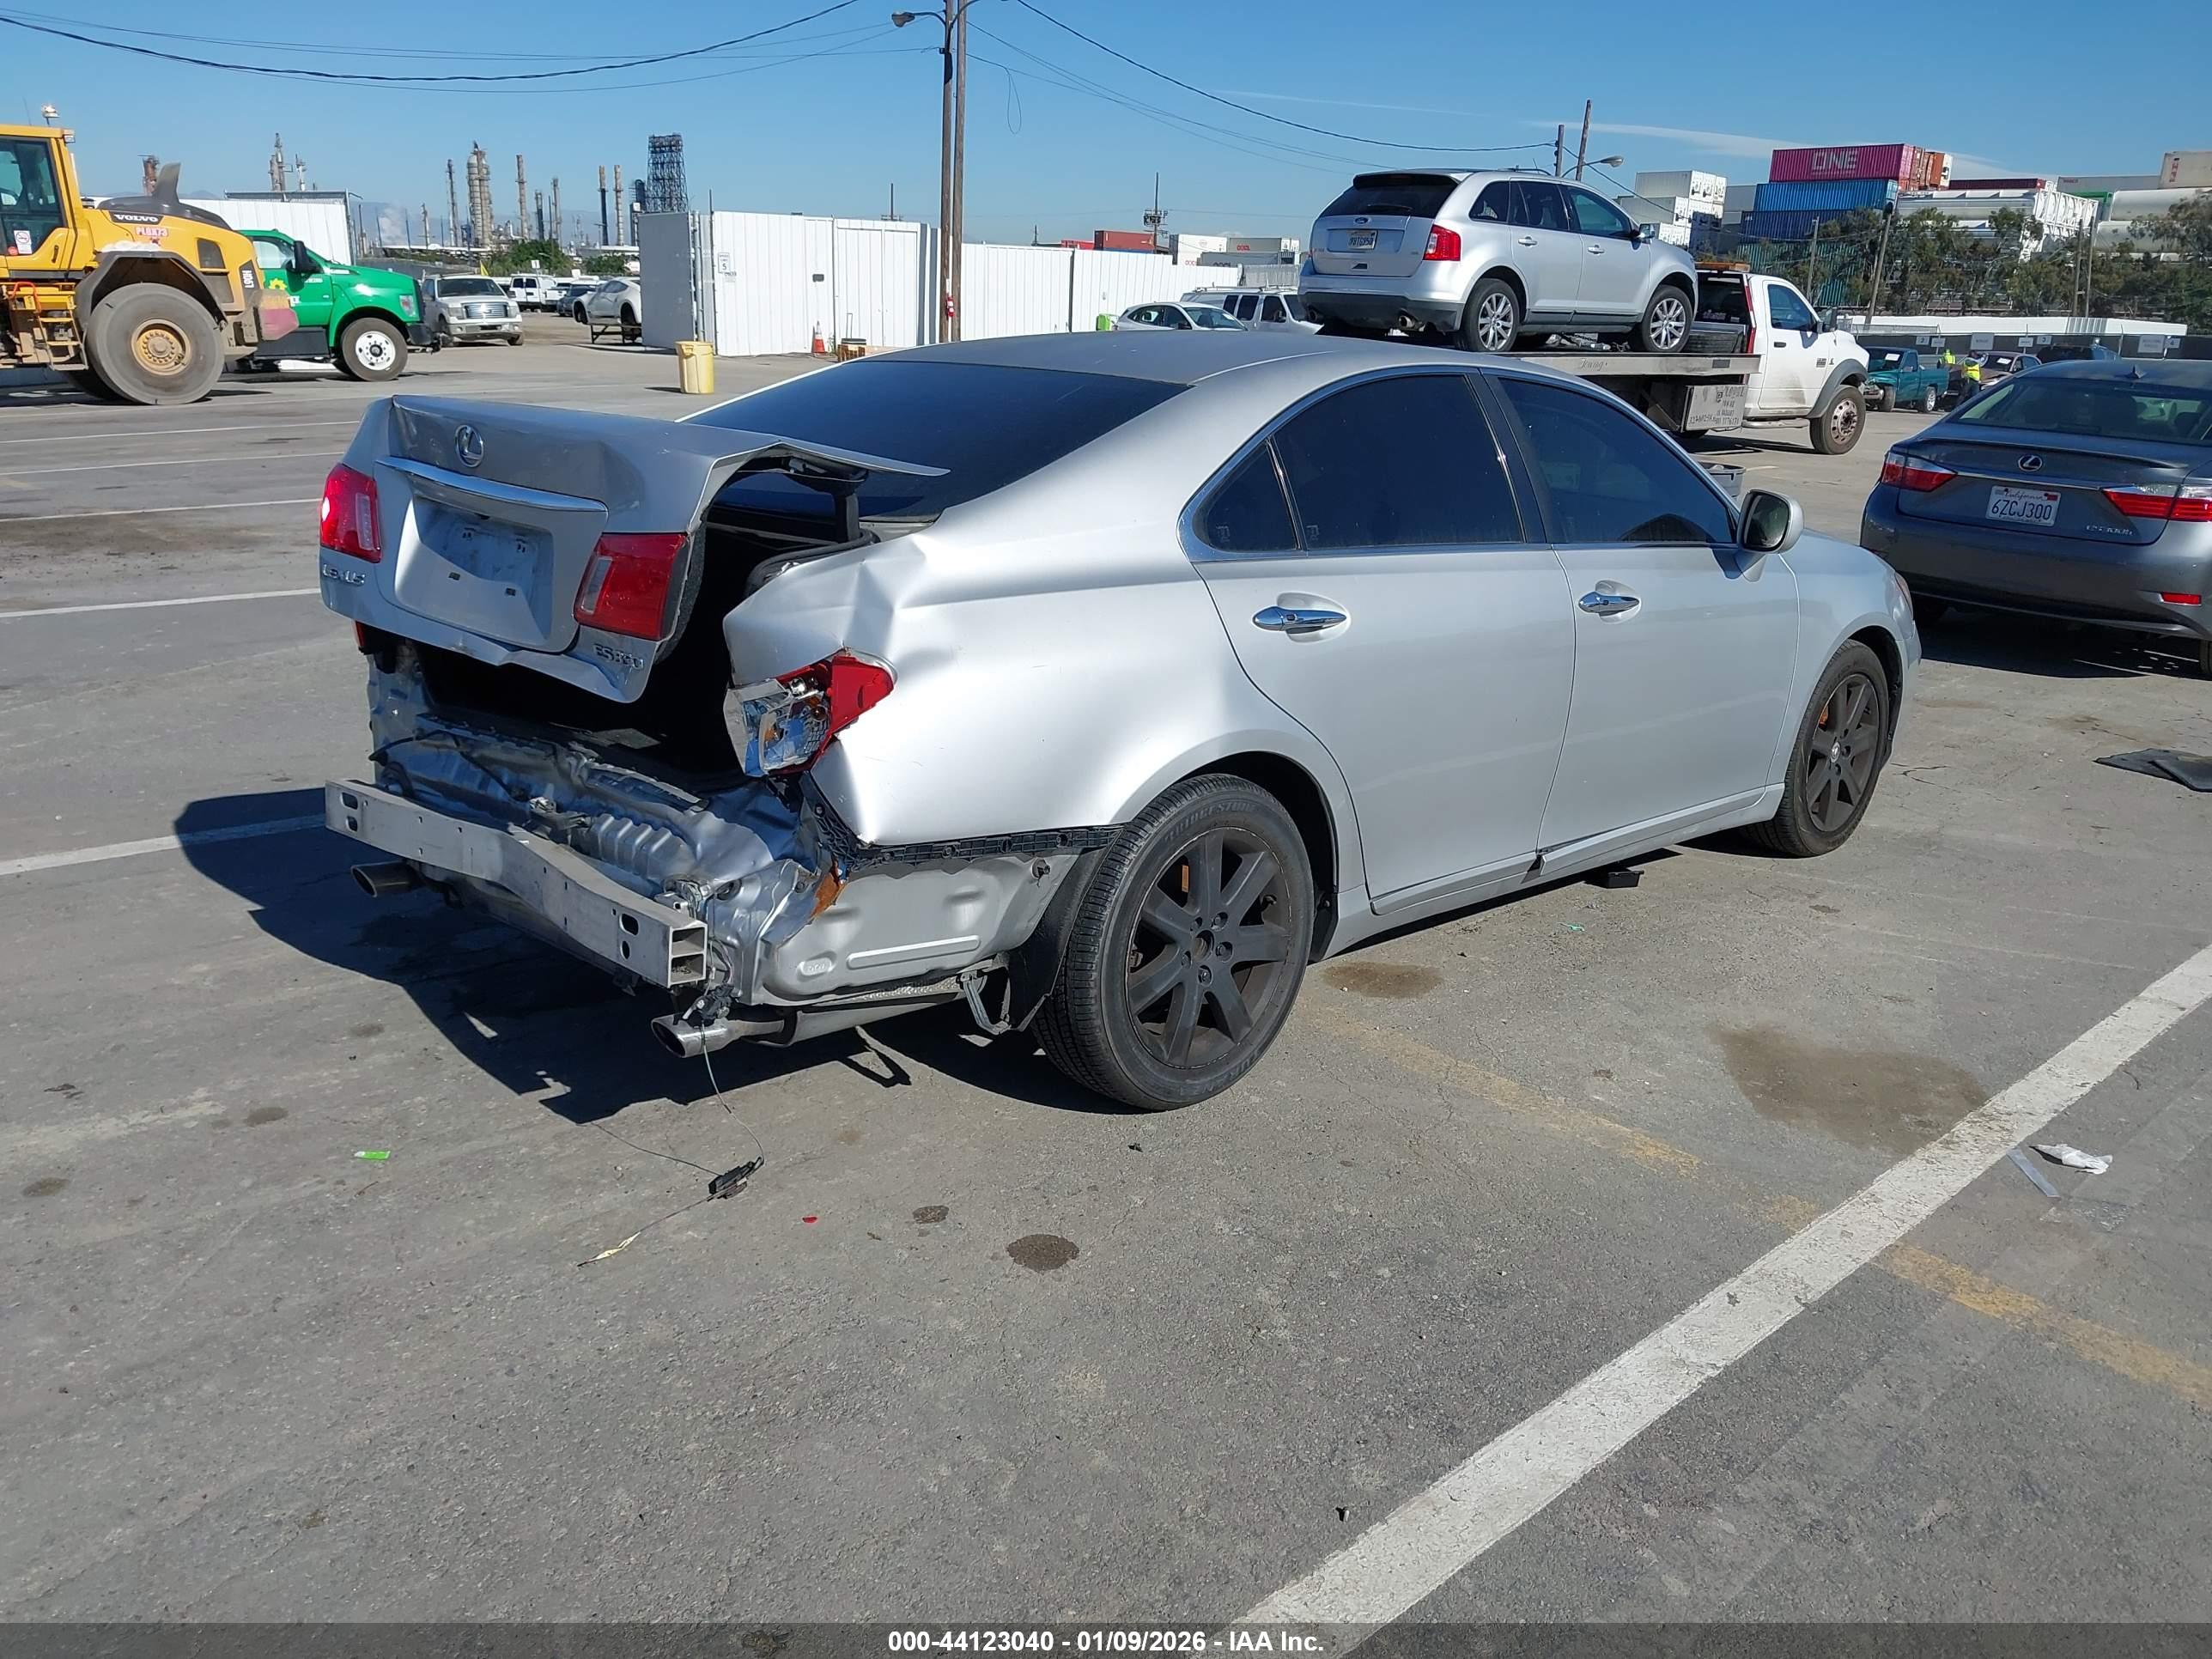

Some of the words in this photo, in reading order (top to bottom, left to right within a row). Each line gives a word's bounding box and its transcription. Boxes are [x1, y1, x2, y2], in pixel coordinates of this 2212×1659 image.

[1812, 150, 1856, 169] ONE
[114, 214, 158, 222] VOLVO
[1991, 499, 2052, 520] 6ZCJ300
